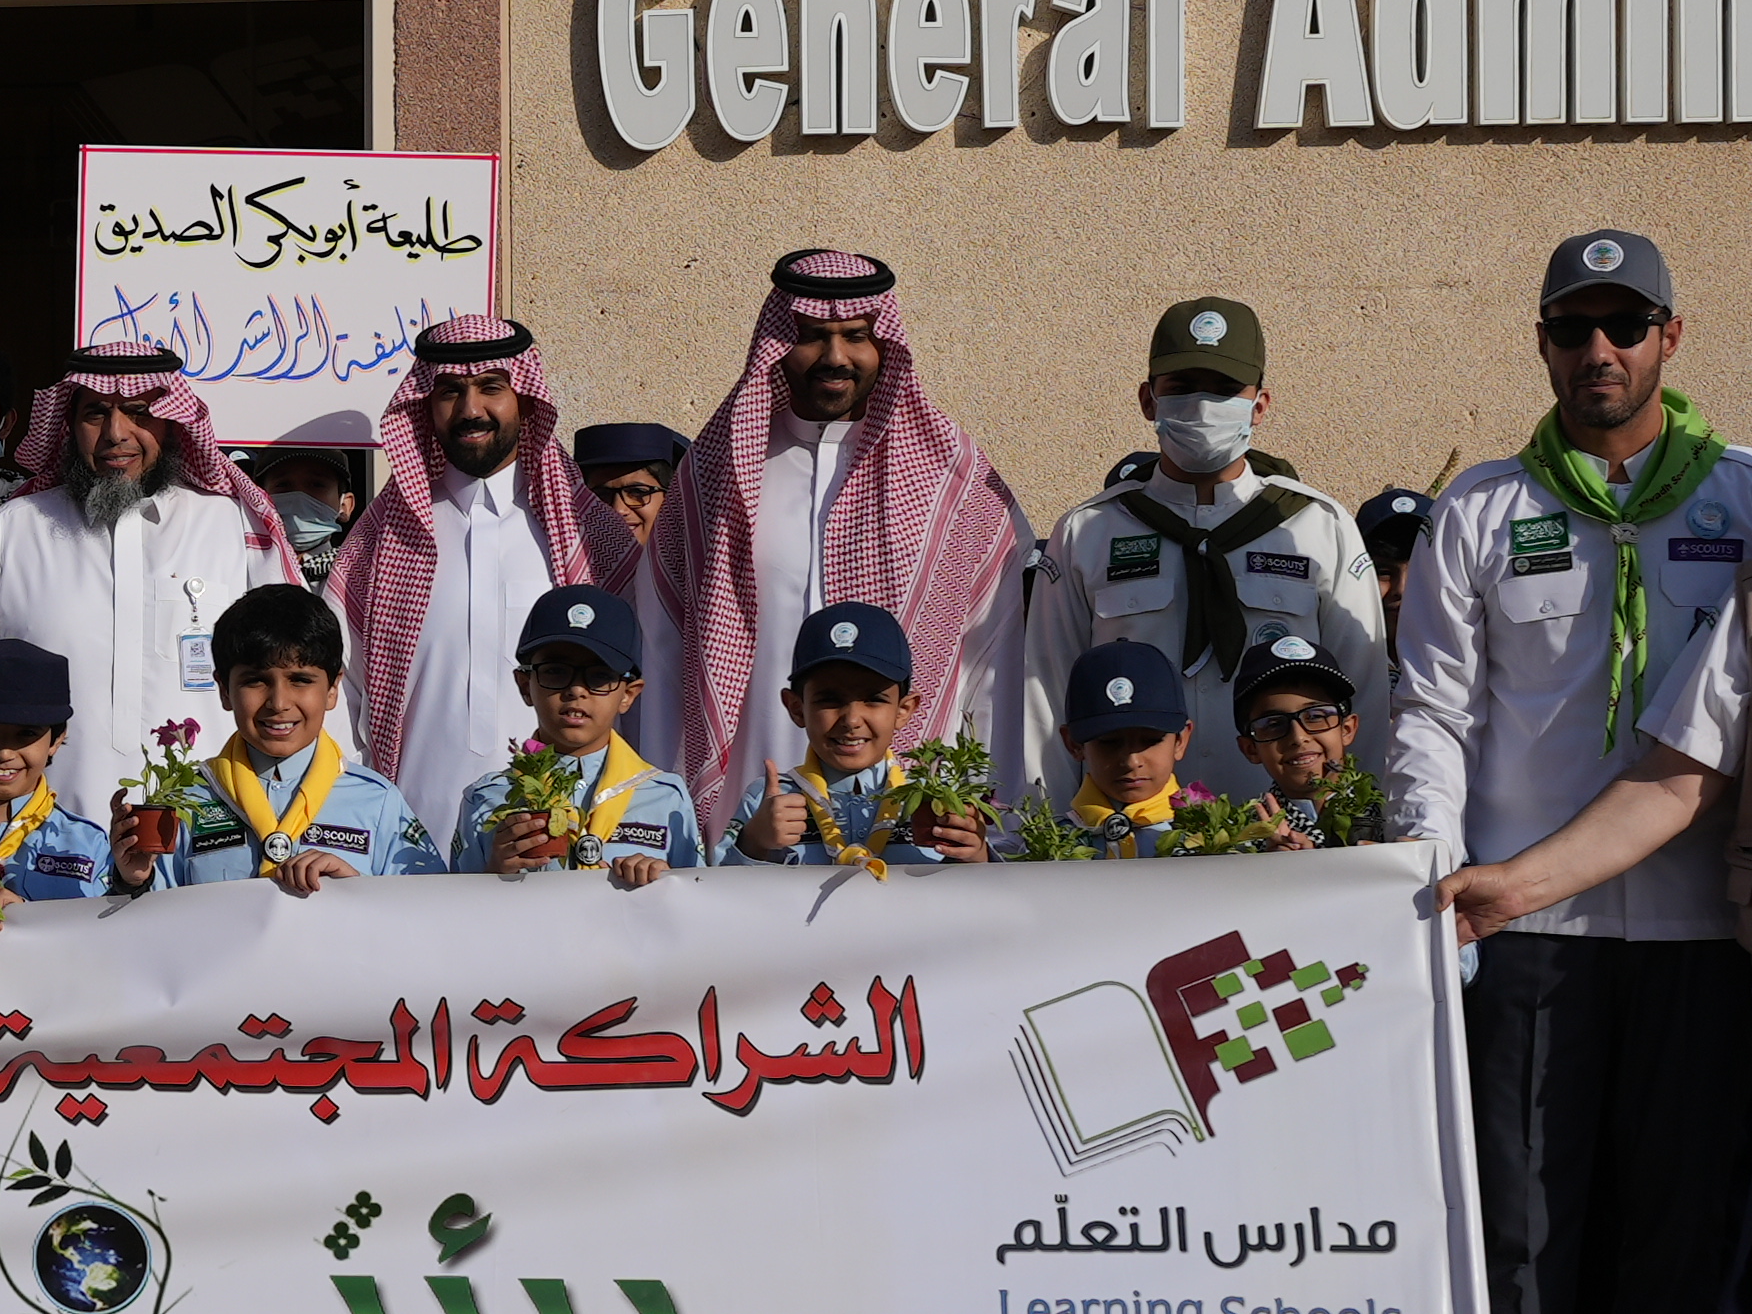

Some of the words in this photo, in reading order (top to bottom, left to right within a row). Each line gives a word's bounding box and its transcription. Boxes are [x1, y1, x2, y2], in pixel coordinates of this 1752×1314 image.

[1690, 544, 1733, 554] SCOUTS
[1267, 559, 1307, 571] SCOUTS
[324, 830, 366, 844] SCOUTS
[622, 827, 664, 841] SCOUTS
[54, 862, 91, 875] SCOUTS
[471, 974, 923, 1114] الشراكة
[1204, 1207, 1397, 1268] مدارس
